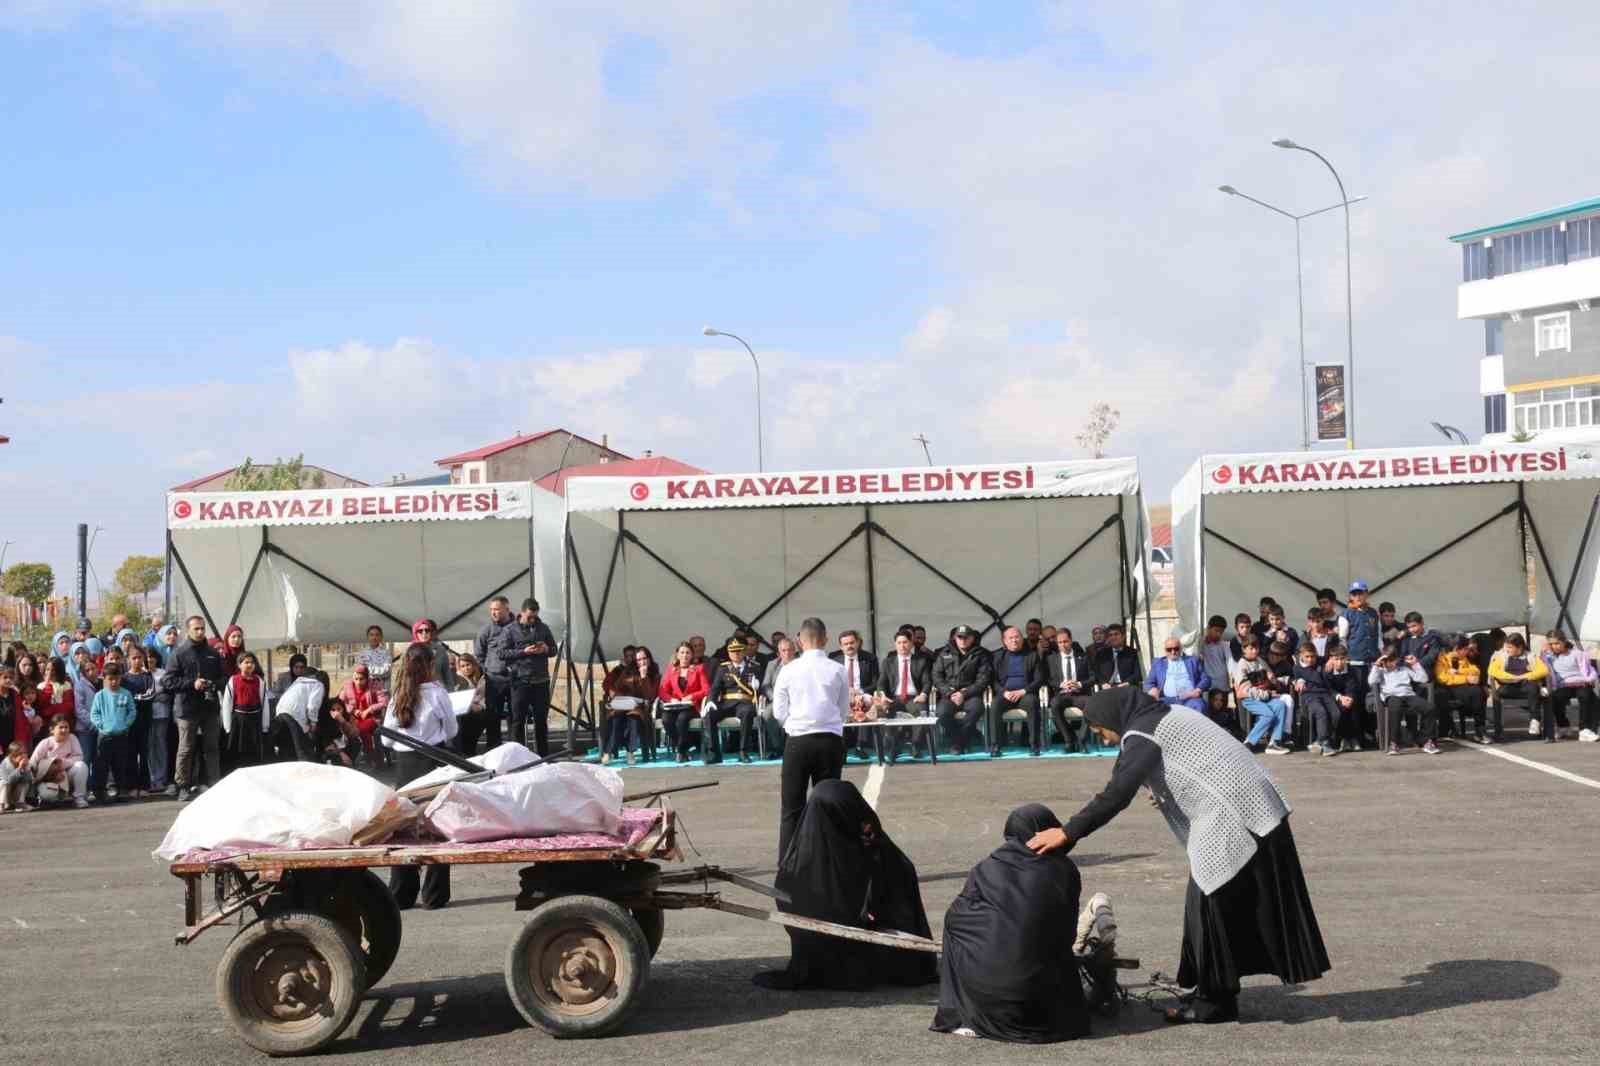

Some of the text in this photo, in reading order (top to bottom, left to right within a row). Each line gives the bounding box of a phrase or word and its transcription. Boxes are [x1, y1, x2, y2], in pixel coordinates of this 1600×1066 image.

[666, 466, 1035, 499] KARAYAZI BELEDİYESİ
[1238, 447, 1567, 485] KARAYAZI BELEDİYESİ
[199, 488, 499, 520] KARAYAZI BELEDİYESİ
